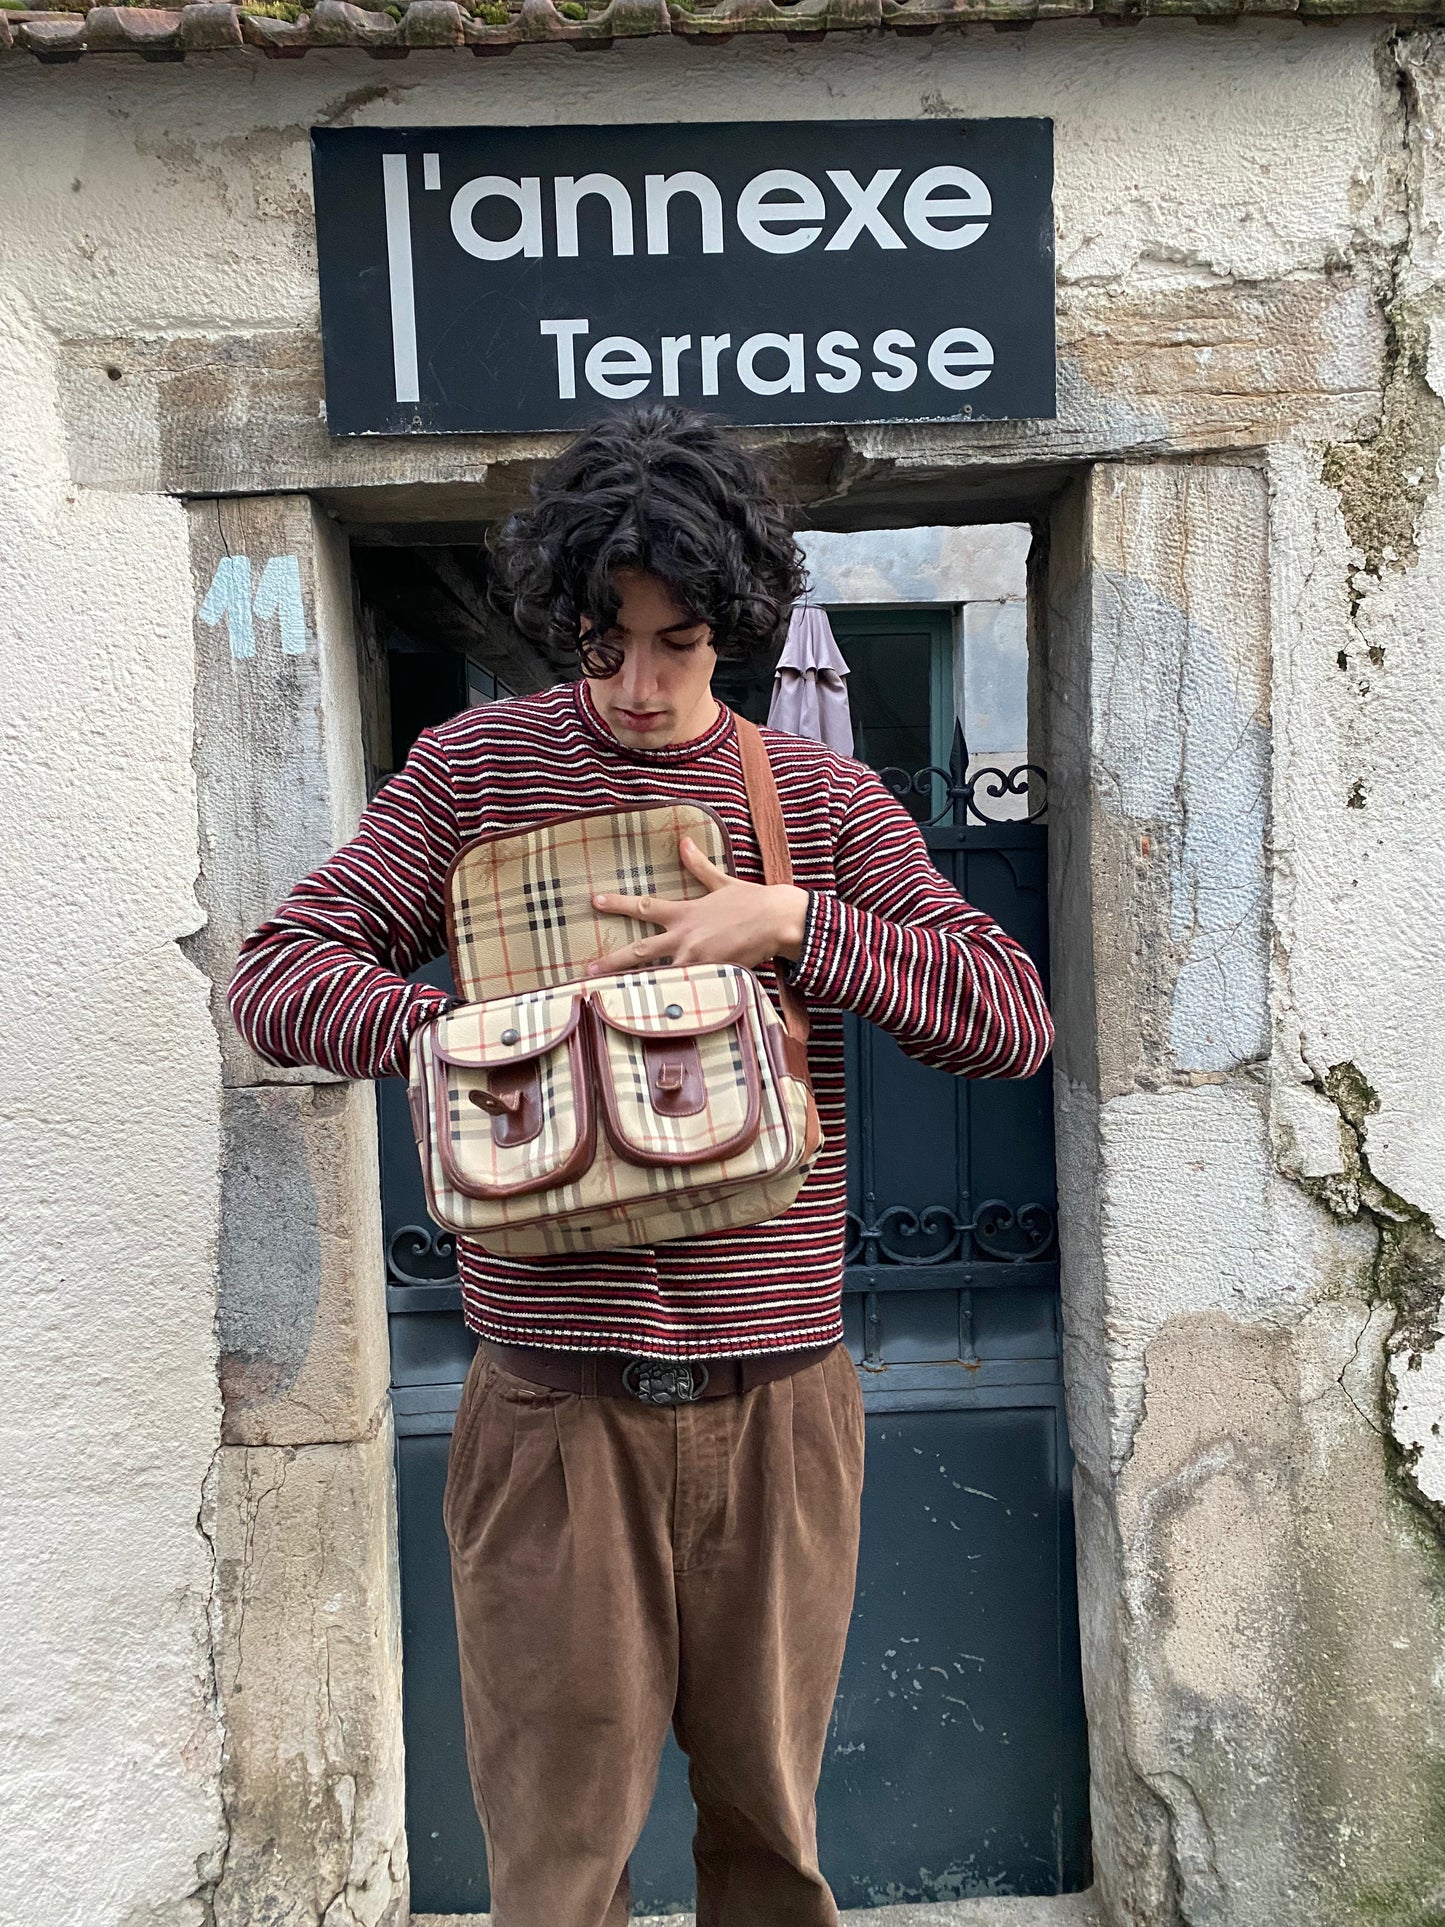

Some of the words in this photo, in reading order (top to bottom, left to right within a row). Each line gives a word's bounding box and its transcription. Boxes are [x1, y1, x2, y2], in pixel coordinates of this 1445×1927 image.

[382, 152, 993, 404] l'annexe
[540, 318, 994, 400] Terrasse
[198, 554, 306, 659] 11
